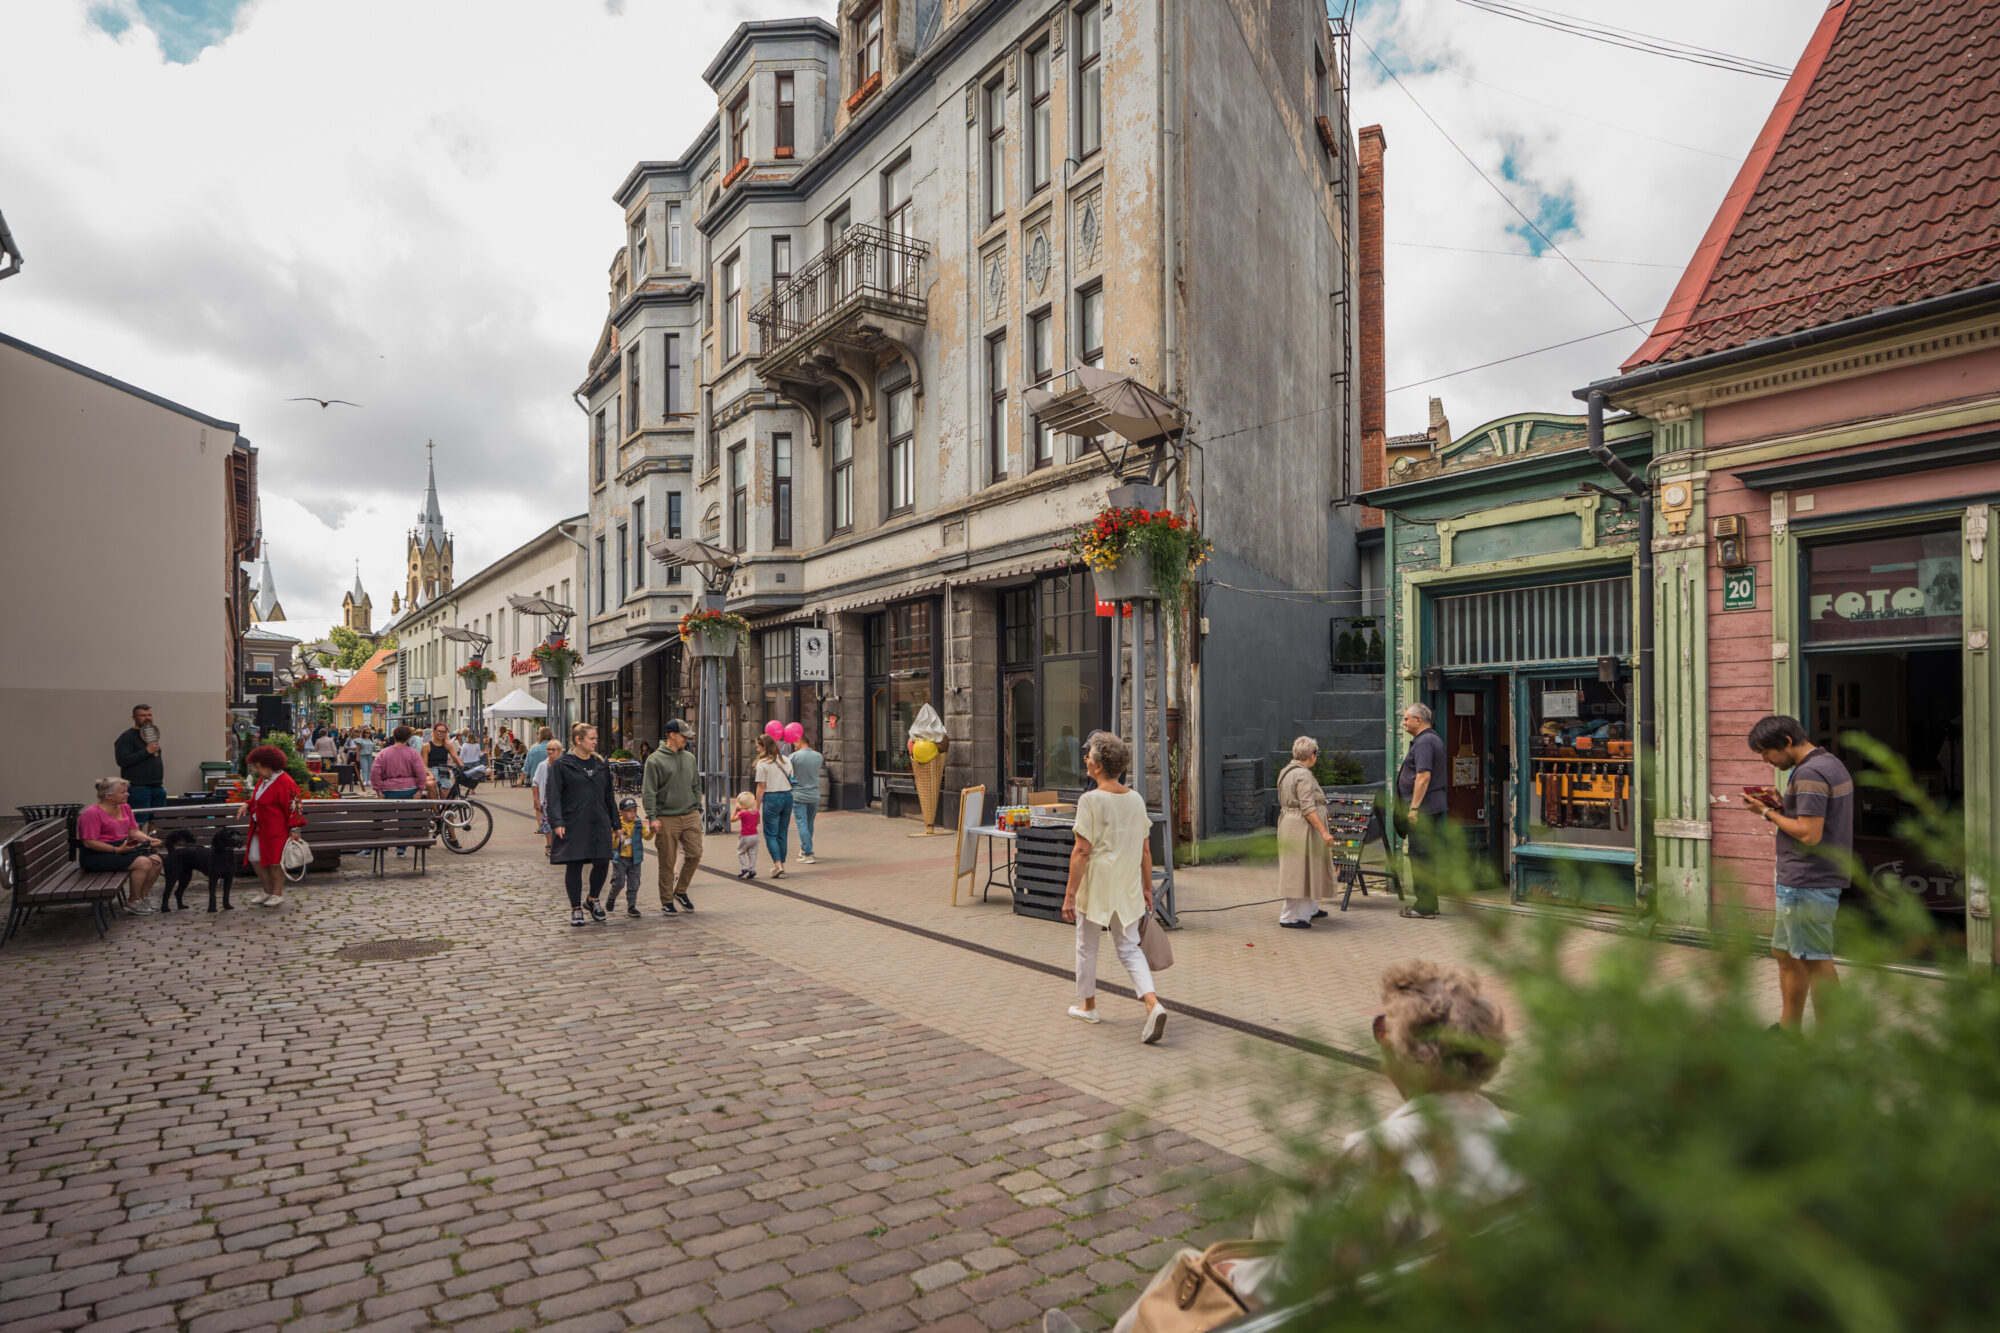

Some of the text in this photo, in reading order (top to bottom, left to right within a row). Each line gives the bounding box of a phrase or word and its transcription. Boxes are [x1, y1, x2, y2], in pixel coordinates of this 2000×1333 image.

[1728, 579, 1751, 599] 20
[1810, 586, 1925, 621] FOTO
[803, 669, 826, 677] CAFE
